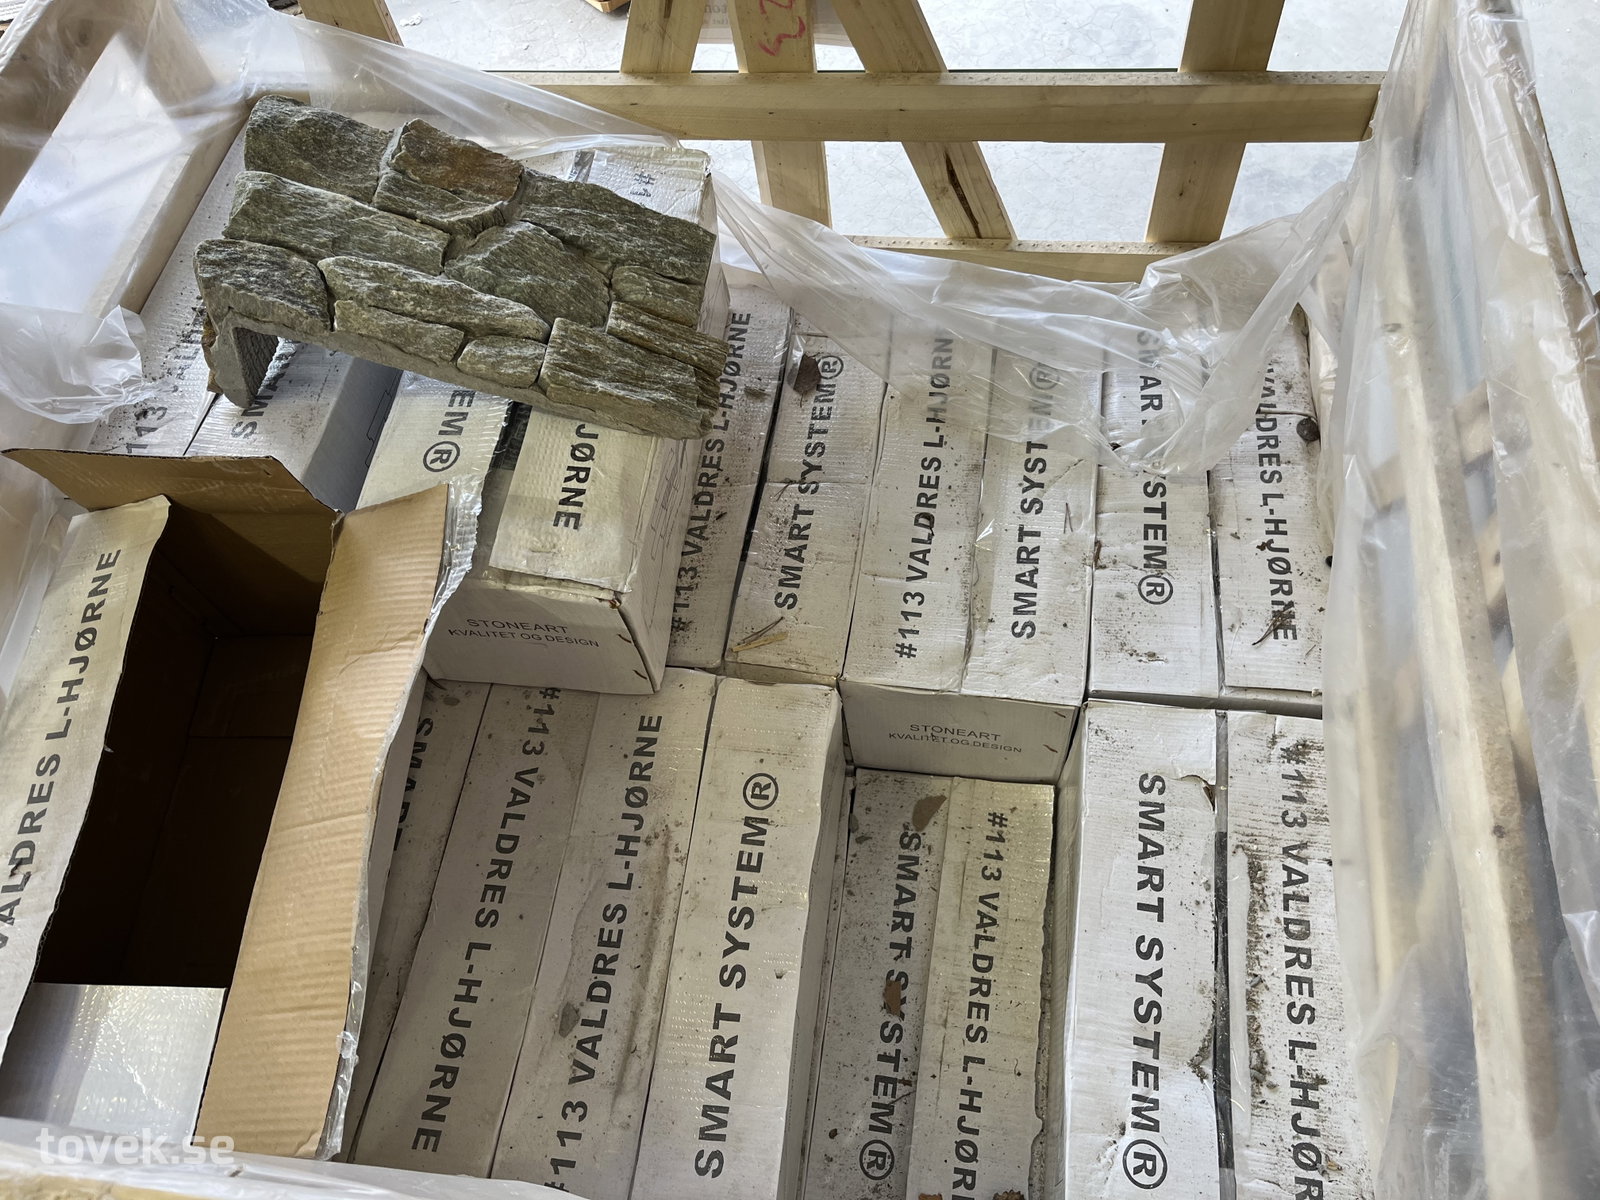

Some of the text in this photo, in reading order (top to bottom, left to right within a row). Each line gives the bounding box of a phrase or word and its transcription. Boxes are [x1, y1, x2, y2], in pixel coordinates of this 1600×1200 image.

[681, 438, 725, 557] VALDRES
[713, 312, 752, 431] L-HJØRNE
[774, 355, 844, 611] SMART SYSTEM®
[894, 337, 954, 659] #113 VALDRES L-HJØRN
[1136, 330, 1174, 605] SMAR STEM®
[45, 549, 122, 740] L-HJØRNE
[448, 629, 600, 647] KVALITET OG DESIGN
[467, 618, 568, 634] STONEART
[1011, 524, 1041, 640] SMART
[1259, 493, 1298, 641] L-HJØRNE
[888, 732, 1022, 753] KVALITET OG DESIGN
[910, 724, 1001, 741] STONEART
[411, 687, 562, 1153] #113 VALDRES L-HJØRNE
[568, 903, 628, 1085] VALDRES
[608, 714, 663, 892] L-HJØRNE
[889, 831, 922, 959] SMART
[982, 812, 1008, 882] #113
[1281, 842, 1316, 1026] VALDRES
[694, 772, 780, 1180] SMART SYSTEM®
[965, 890, 1001, 1044] VALDRES
[1122, 773, 1168, 1189] SMART SYSTEM®
